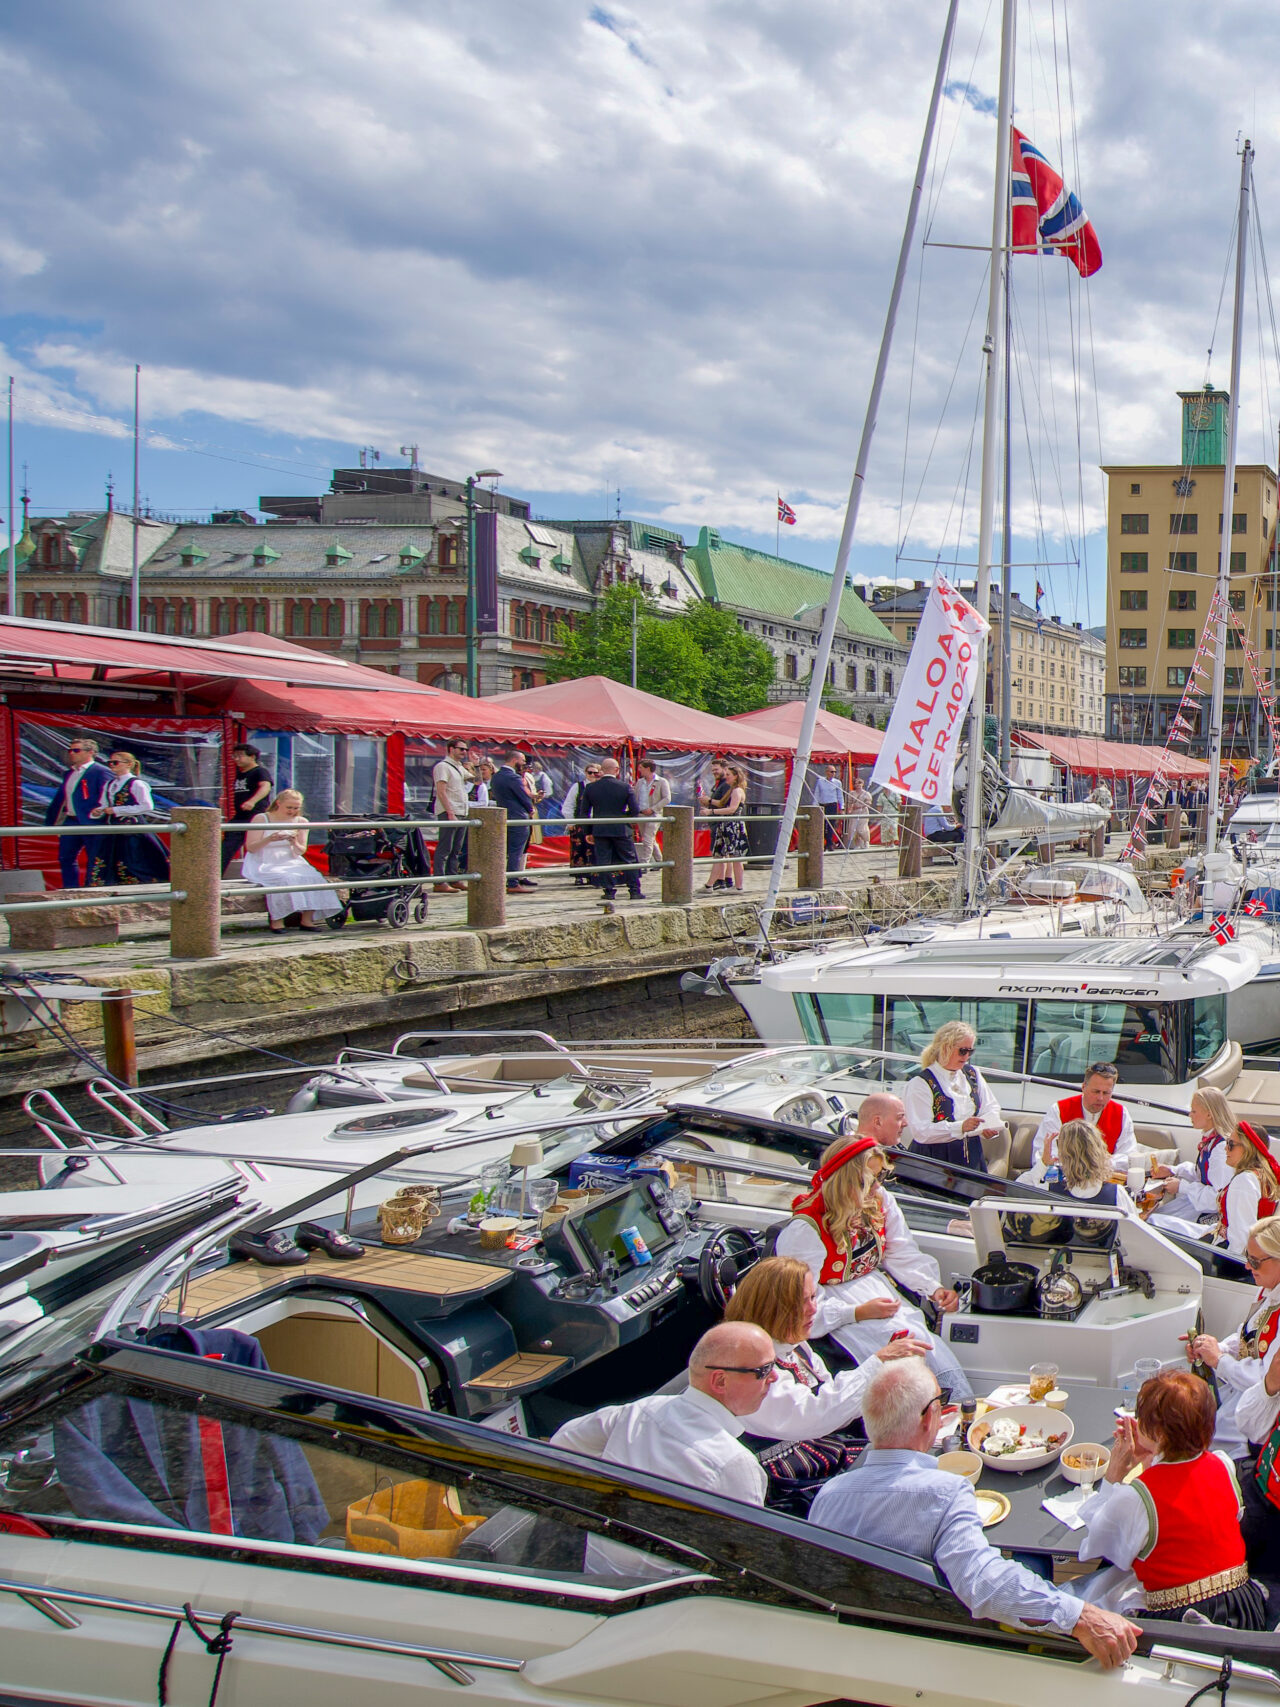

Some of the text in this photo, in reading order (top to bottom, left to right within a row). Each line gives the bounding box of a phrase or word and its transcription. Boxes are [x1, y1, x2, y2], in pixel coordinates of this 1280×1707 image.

[889, 632, 955, 792] KIALOA
[920, 641, 972, 801] GER-4020
[998, 985, 1159, 997] AXOPAR BERGEN
[1138, 1034, 1162, 1042] 28
